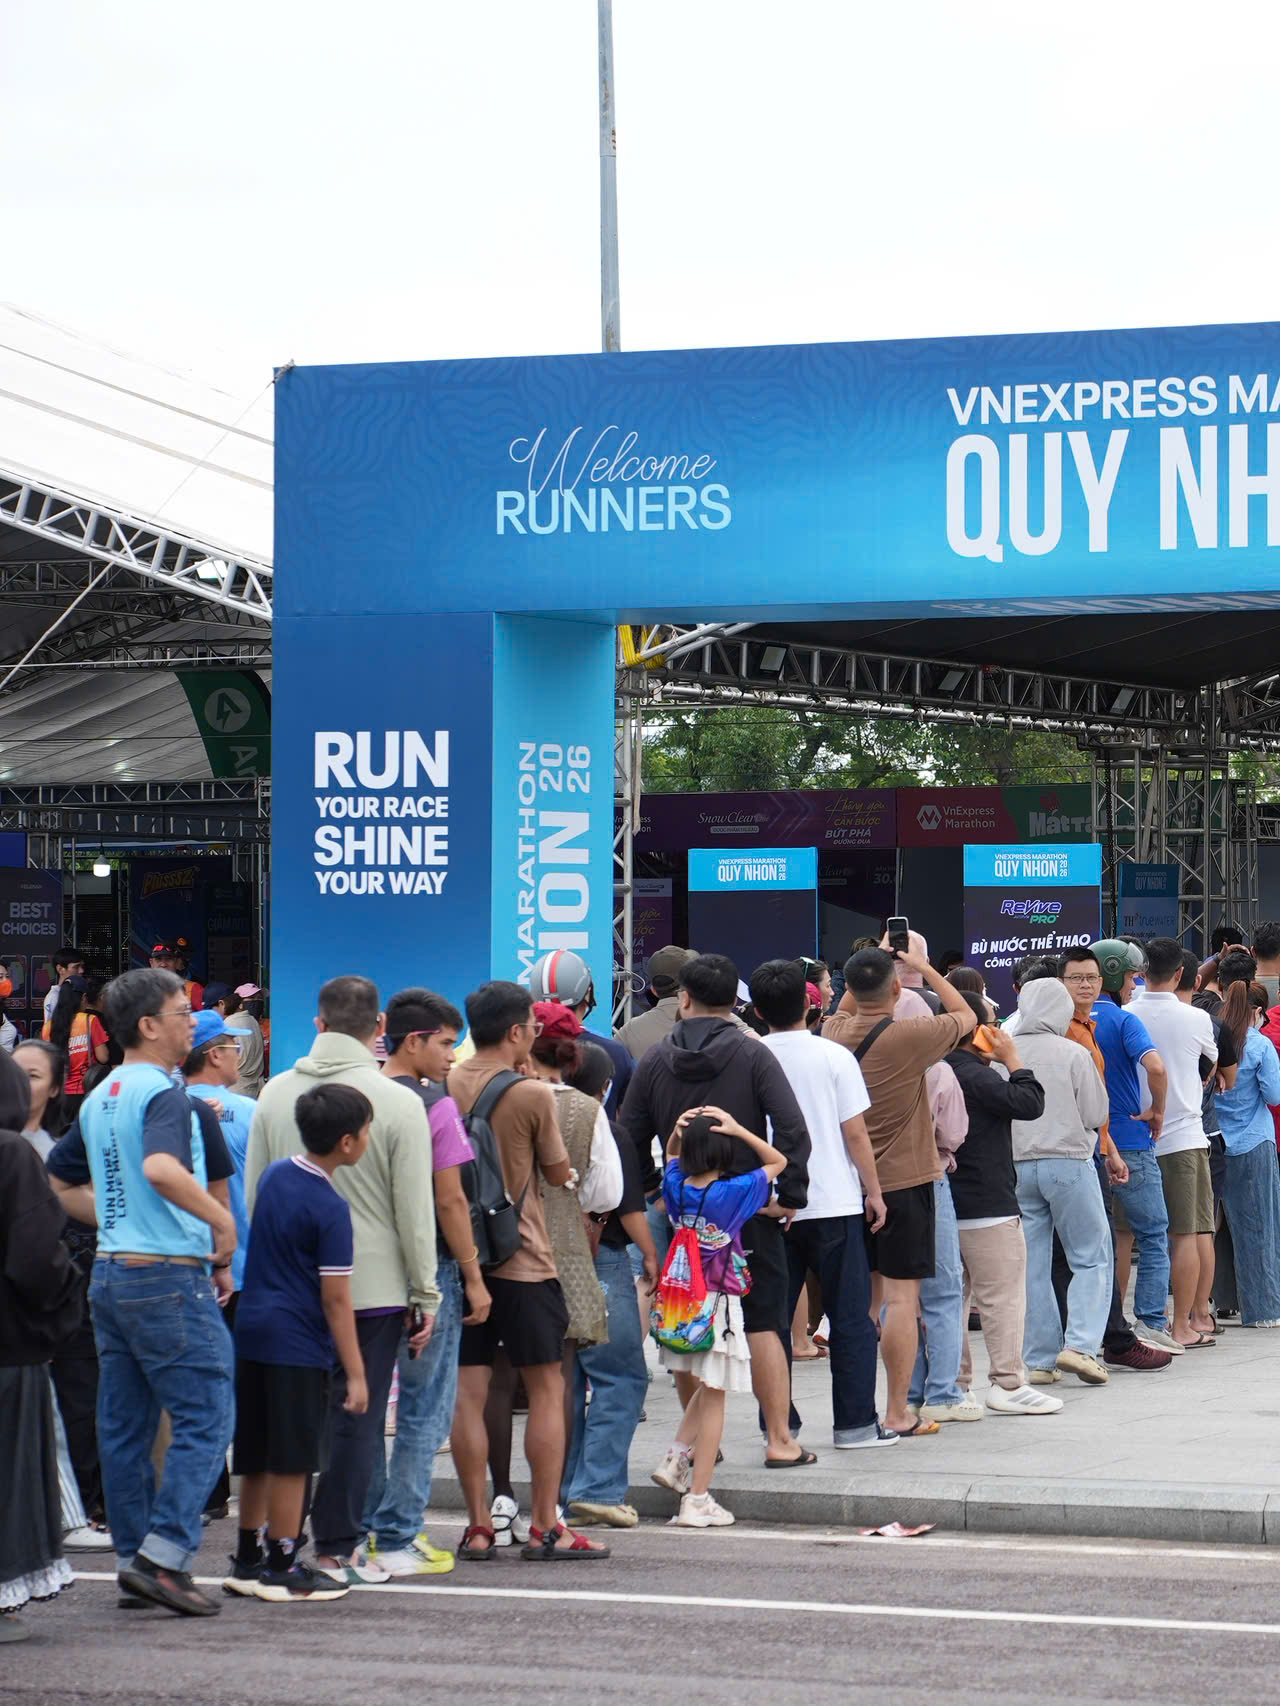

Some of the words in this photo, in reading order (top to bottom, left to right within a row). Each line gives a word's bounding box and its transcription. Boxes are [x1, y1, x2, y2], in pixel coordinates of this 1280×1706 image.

[947, 375, 1217, 425] VNEXPRESS
[509, 425, 717, 497] Welcome
[946, 428, 1129, 563] QUY
[496, 483, 731, 534] RUNNERS
[314, 730, 449, 789] RUN
[538, 743, 563, 793] 20
[566, 745, 591, 793] 26
[315, 797, 380, 818] YOUR
[384, 796, 449, 818] RACE
[943, 805, 995, 818] VnExpress
[849, 827, 872, 838] PHÁ
[945, 818, 996, 830] Marathon
[314, 825, 449, 866] SHINE
[517, 742, 537, 986] MARATHON
[718, 865, 743, 882] QUY
[746, 864, 777, 881] NHON
[995, 861, 1018, 877] QUY
[1023, 860, 1058, 877] NHON
[314, 871, 385, 895] YOUR
[390, 871, 448, 895] WAY
[9, 902, 52, 918] BEST
[1001, 900, 1061, 915] ReVive
[2, 922, 56, 935] CHOICES
[1029, 915, 1057, 924] PRO
[971, 938, 988, 954] BÙ
[990, 937, 1027, 953] NƯỚC
[1030, 931, 1056, 950] THỂ
[1056, 934, 1091, 948] THAO
[984, 957, 1012, 968] CÔNG
[103, 1146, 115, 1193] MORE
[104, 1197, 116, 1230] RUN
